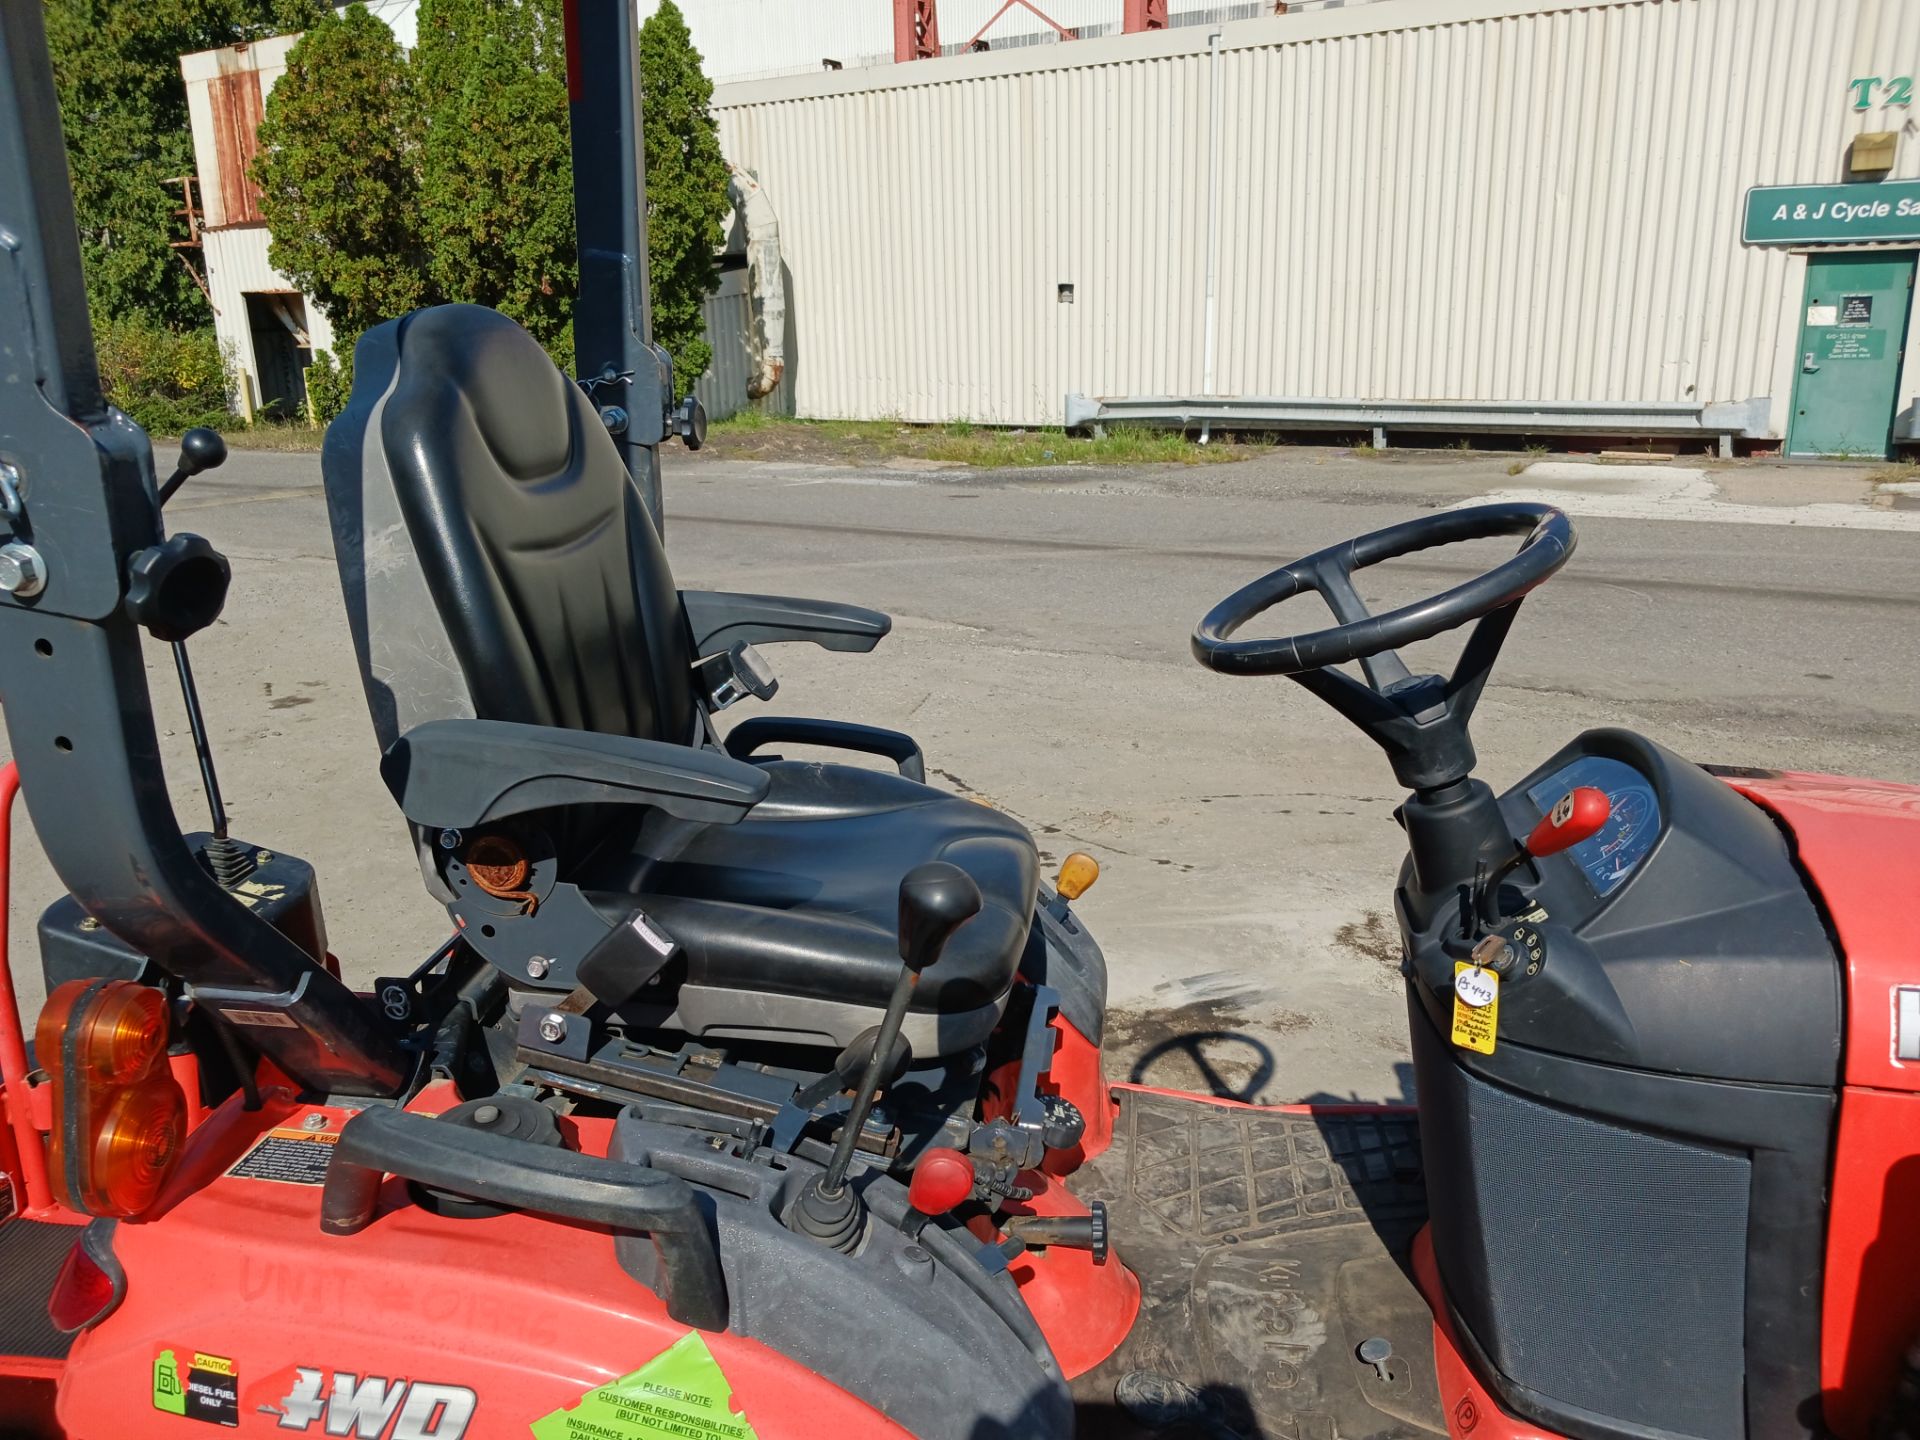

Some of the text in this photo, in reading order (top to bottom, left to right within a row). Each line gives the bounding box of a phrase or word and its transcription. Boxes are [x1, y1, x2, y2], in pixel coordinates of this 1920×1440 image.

[1772, 204, 1787, 221] A
[1793, 203, 1807, 220] &
[1812, 202, 1826, 220] J
[1831, 200, 1890, 222] Cycle
[200, 1396, 222, 1408] ONLY
[215, 1389, 237, 1400] FUEL
[643, 1382, 712, 1407] PLEASE NOTE:
[598, 1391, 746, 1438] CUSTOMER RESPONSIBILITIES:
[616, 1409, 640, 1424] (BUT
[642, 1415, 663, 1429] NOT
[665, 1422, 704, 1440] LIMITED
[567, 1418, 624, 1440] INSURANCE
